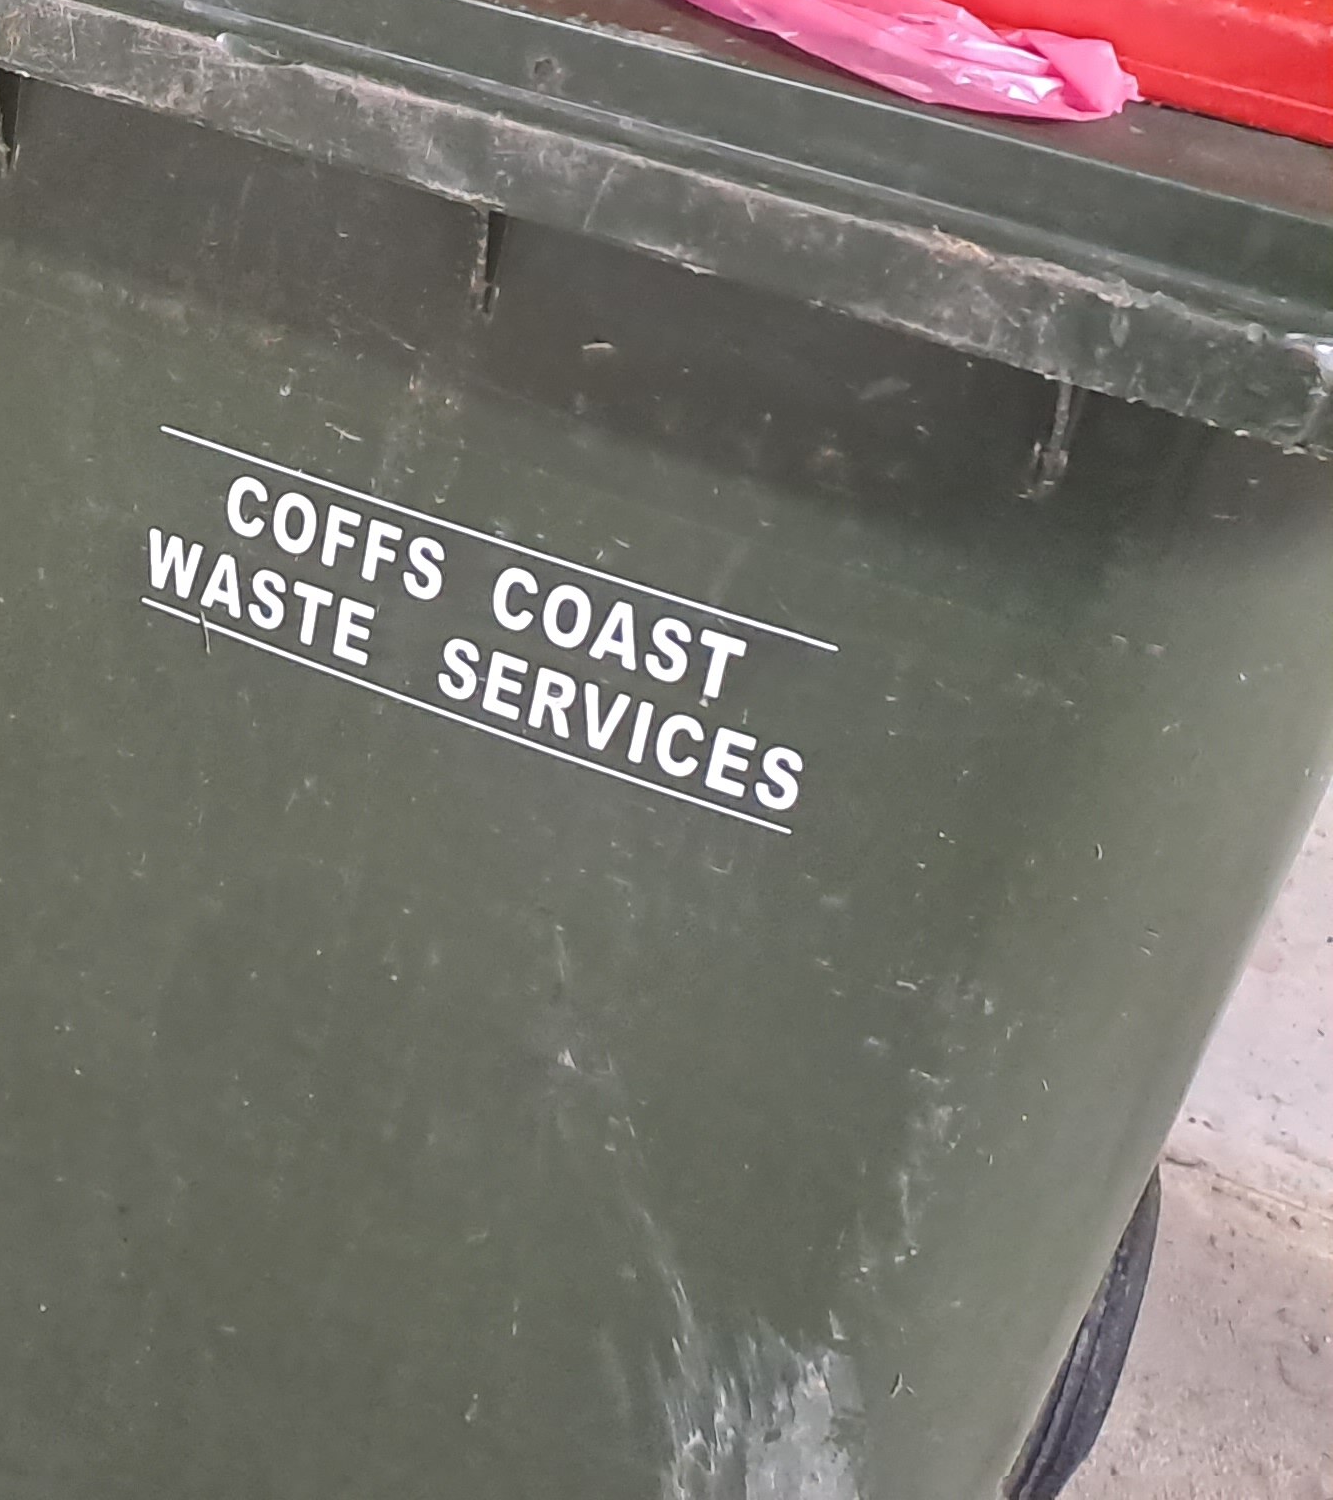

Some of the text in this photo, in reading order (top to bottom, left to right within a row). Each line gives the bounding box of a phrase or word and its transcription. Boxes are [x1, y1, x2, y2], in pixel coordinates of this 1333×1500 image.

[148, 527, 804, 811] WASTE SERVICES
[226, 475, 747, 699] COFFS COAST
